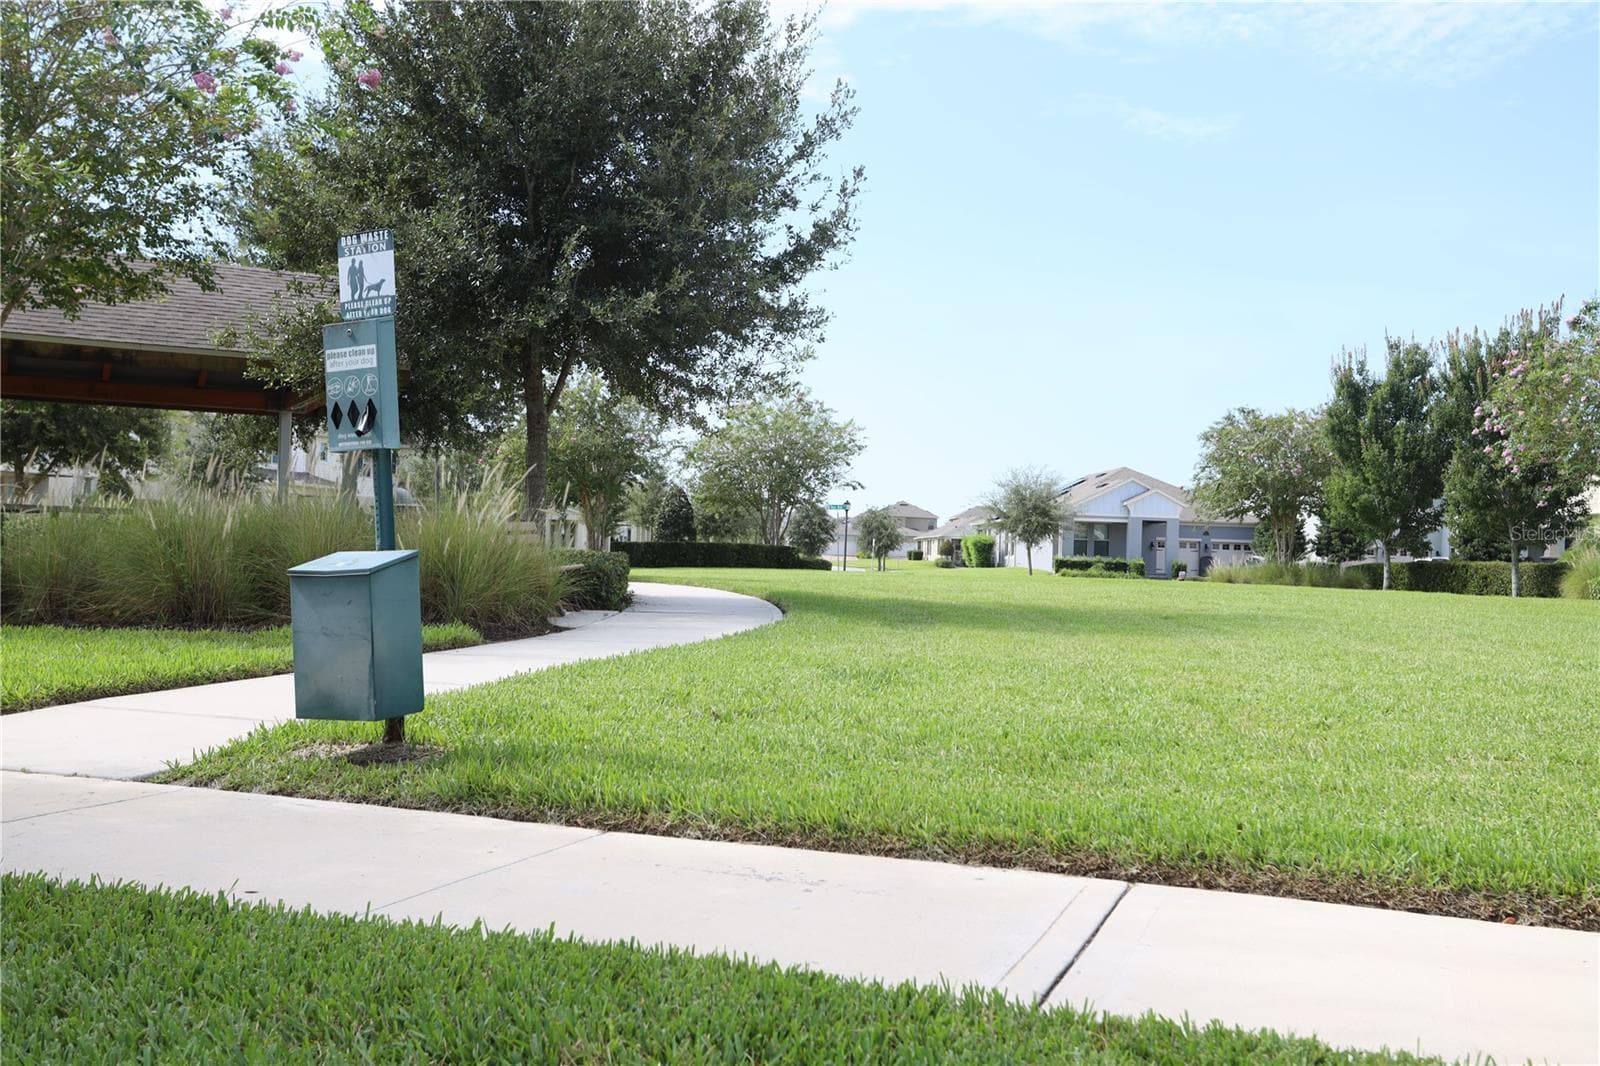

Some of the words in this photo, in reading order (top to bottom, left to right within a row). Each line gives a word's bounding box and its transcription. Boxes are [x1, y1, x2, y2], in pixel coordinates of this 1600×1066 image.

[341, 235, 358, 247] DOG
[360, 230, 389, 244] WASTE
[326, 351, 348, 360] please
[348, 348, 366, 357] clean
